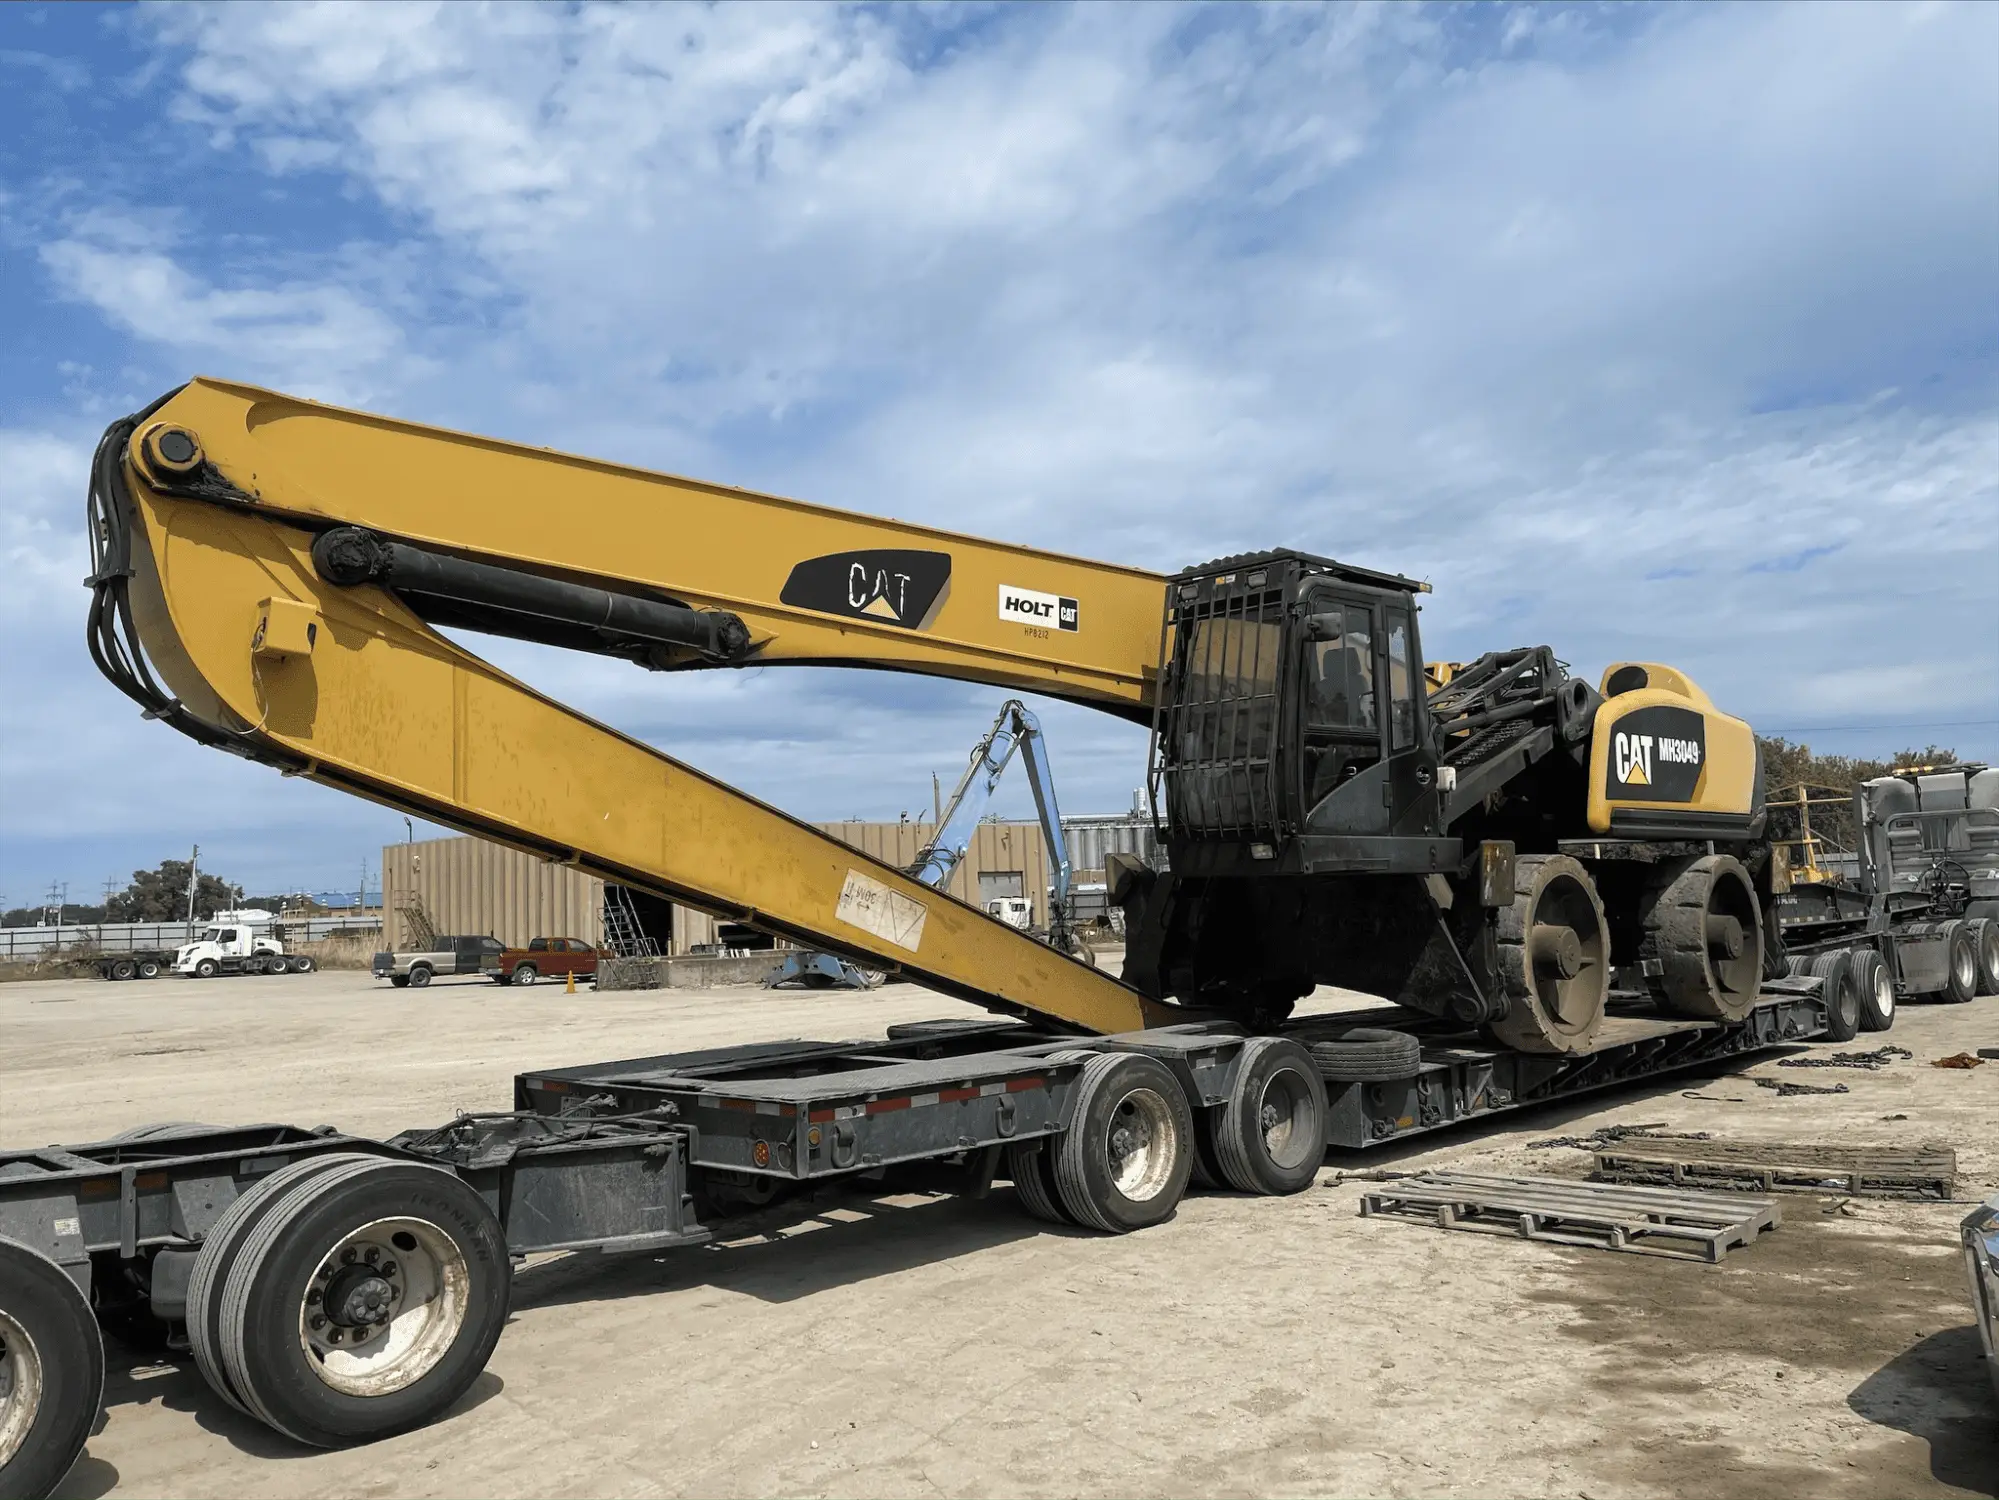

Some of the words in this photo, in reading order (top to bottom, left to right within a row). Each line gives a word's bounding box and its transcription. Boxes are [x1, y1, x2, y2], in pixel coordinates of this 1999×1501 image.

[849, 562, 911, 617] CAT
[1005, 596, 1054, 617] HOLT
[1060, 606, 1077, 623] CAT
[1615, 732, 1653, 785] CAT
[1658, 737, 1699, 764] MH3049
[410, 1193, 490, 1262] IRONMAN
